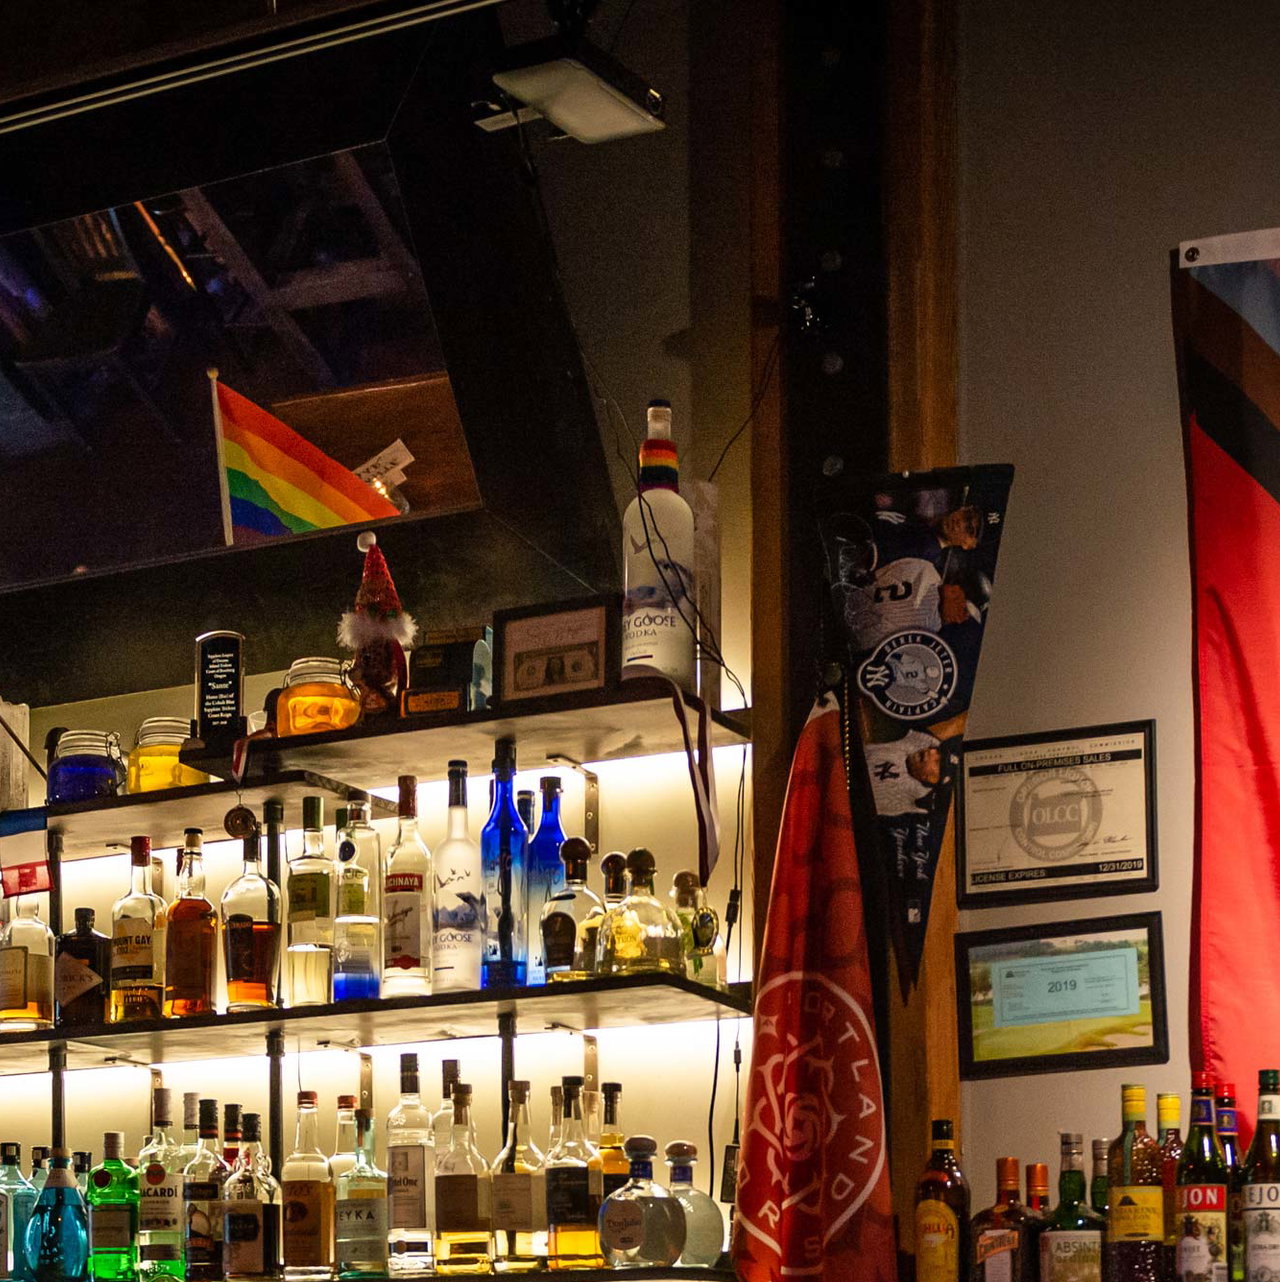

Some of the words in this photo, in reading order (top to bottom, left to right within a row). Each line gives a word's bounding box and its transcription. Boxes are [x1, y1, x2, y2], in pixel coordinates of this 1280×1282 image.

[633, 614, 677, 627] GOOSE
[998, 761, 1019, 773] FULL
[1020, 755, 1081, 770] ON-PREMISES
[1083, 752, 1112, 763] SALES
[1032, 803, 1080, 824] OLCC
[971, 872, 1006, 884] LICENSE
[1008, 869, 1047, 881] EXPIRES
[1098, 859, 1144, 873] 12/31/2019
[135, 935, 152, 945] GAY
[440, 933, 473, 943] GOOSE
[1047, 979, 1078, 993] 2019
[1182, 1188, 1218, 1208] JON
